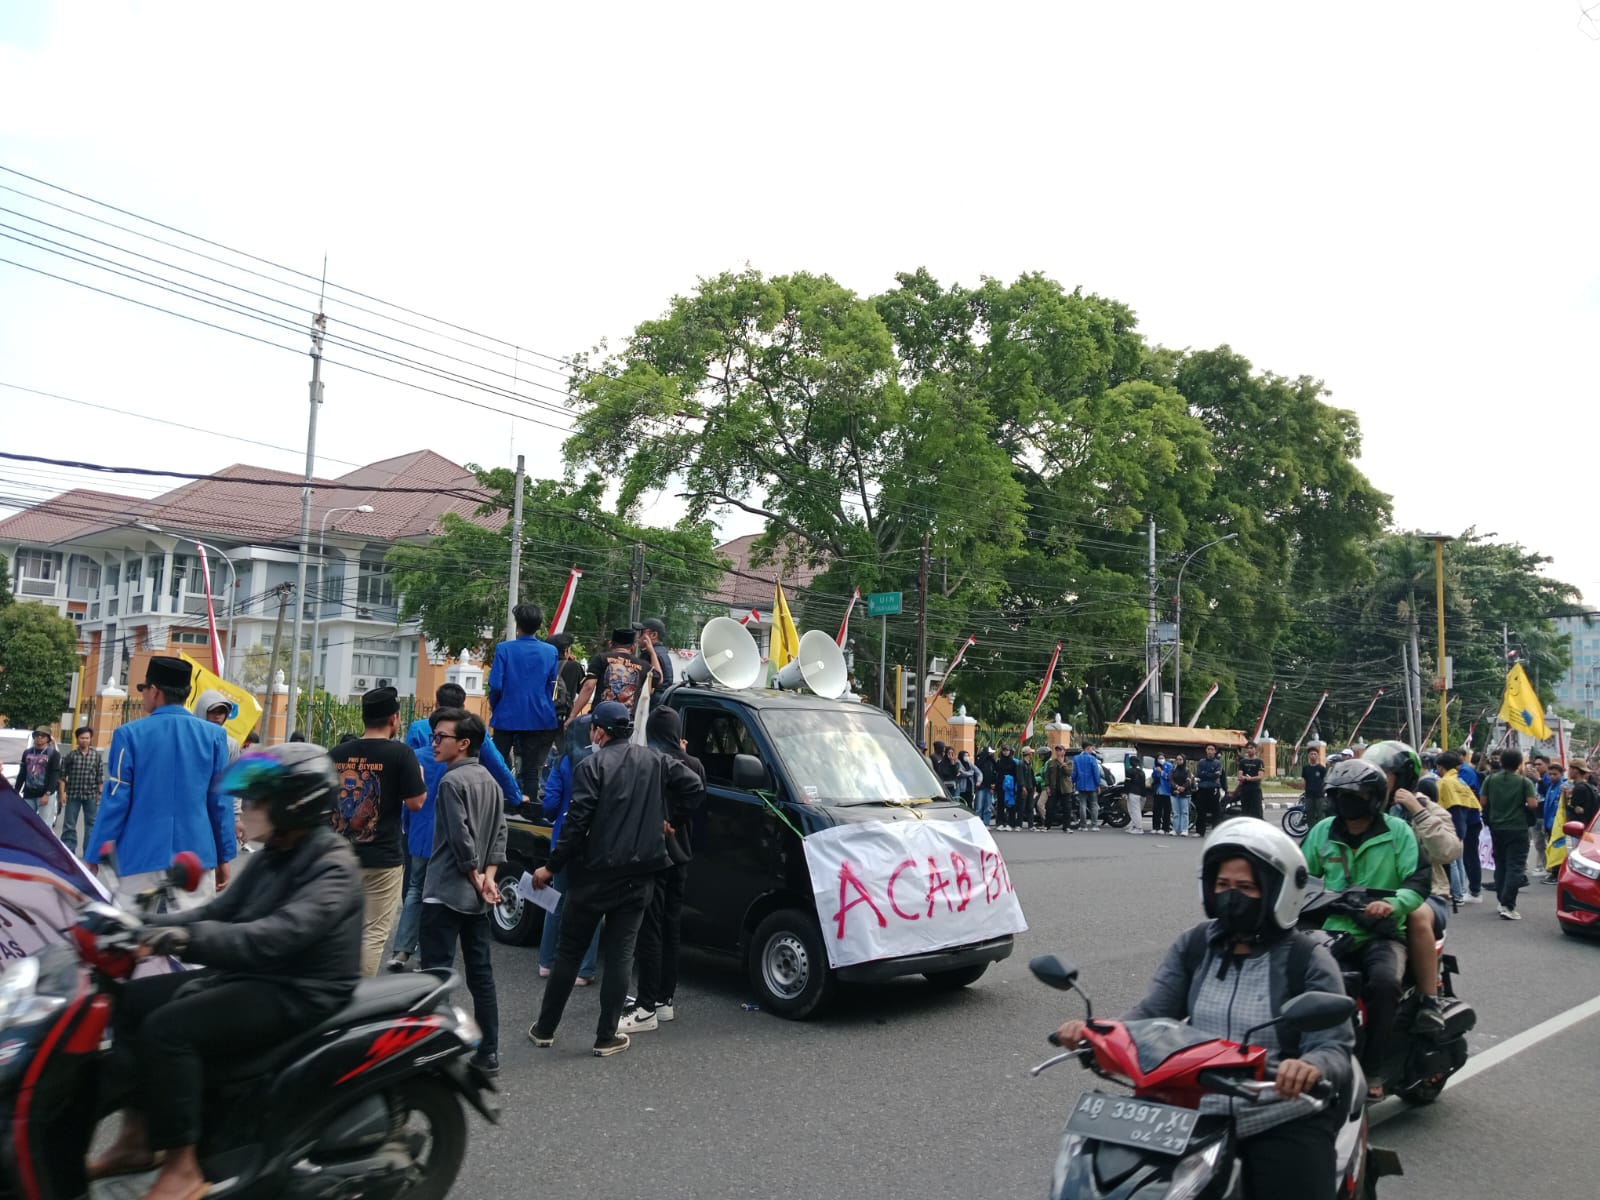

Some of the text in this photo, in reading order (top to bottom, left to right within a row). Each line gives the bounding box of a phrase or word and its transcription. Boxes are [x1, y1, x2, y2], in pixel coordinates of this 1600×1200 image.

[880, 595, 895, 604] UIN
[833, 849, 1014, 939] ACAB 131
[0, 940, 27, 959] AS
[1080, 1097, 1104, 1113] AB
[1111, 1102, 1161, 1124] 3397
